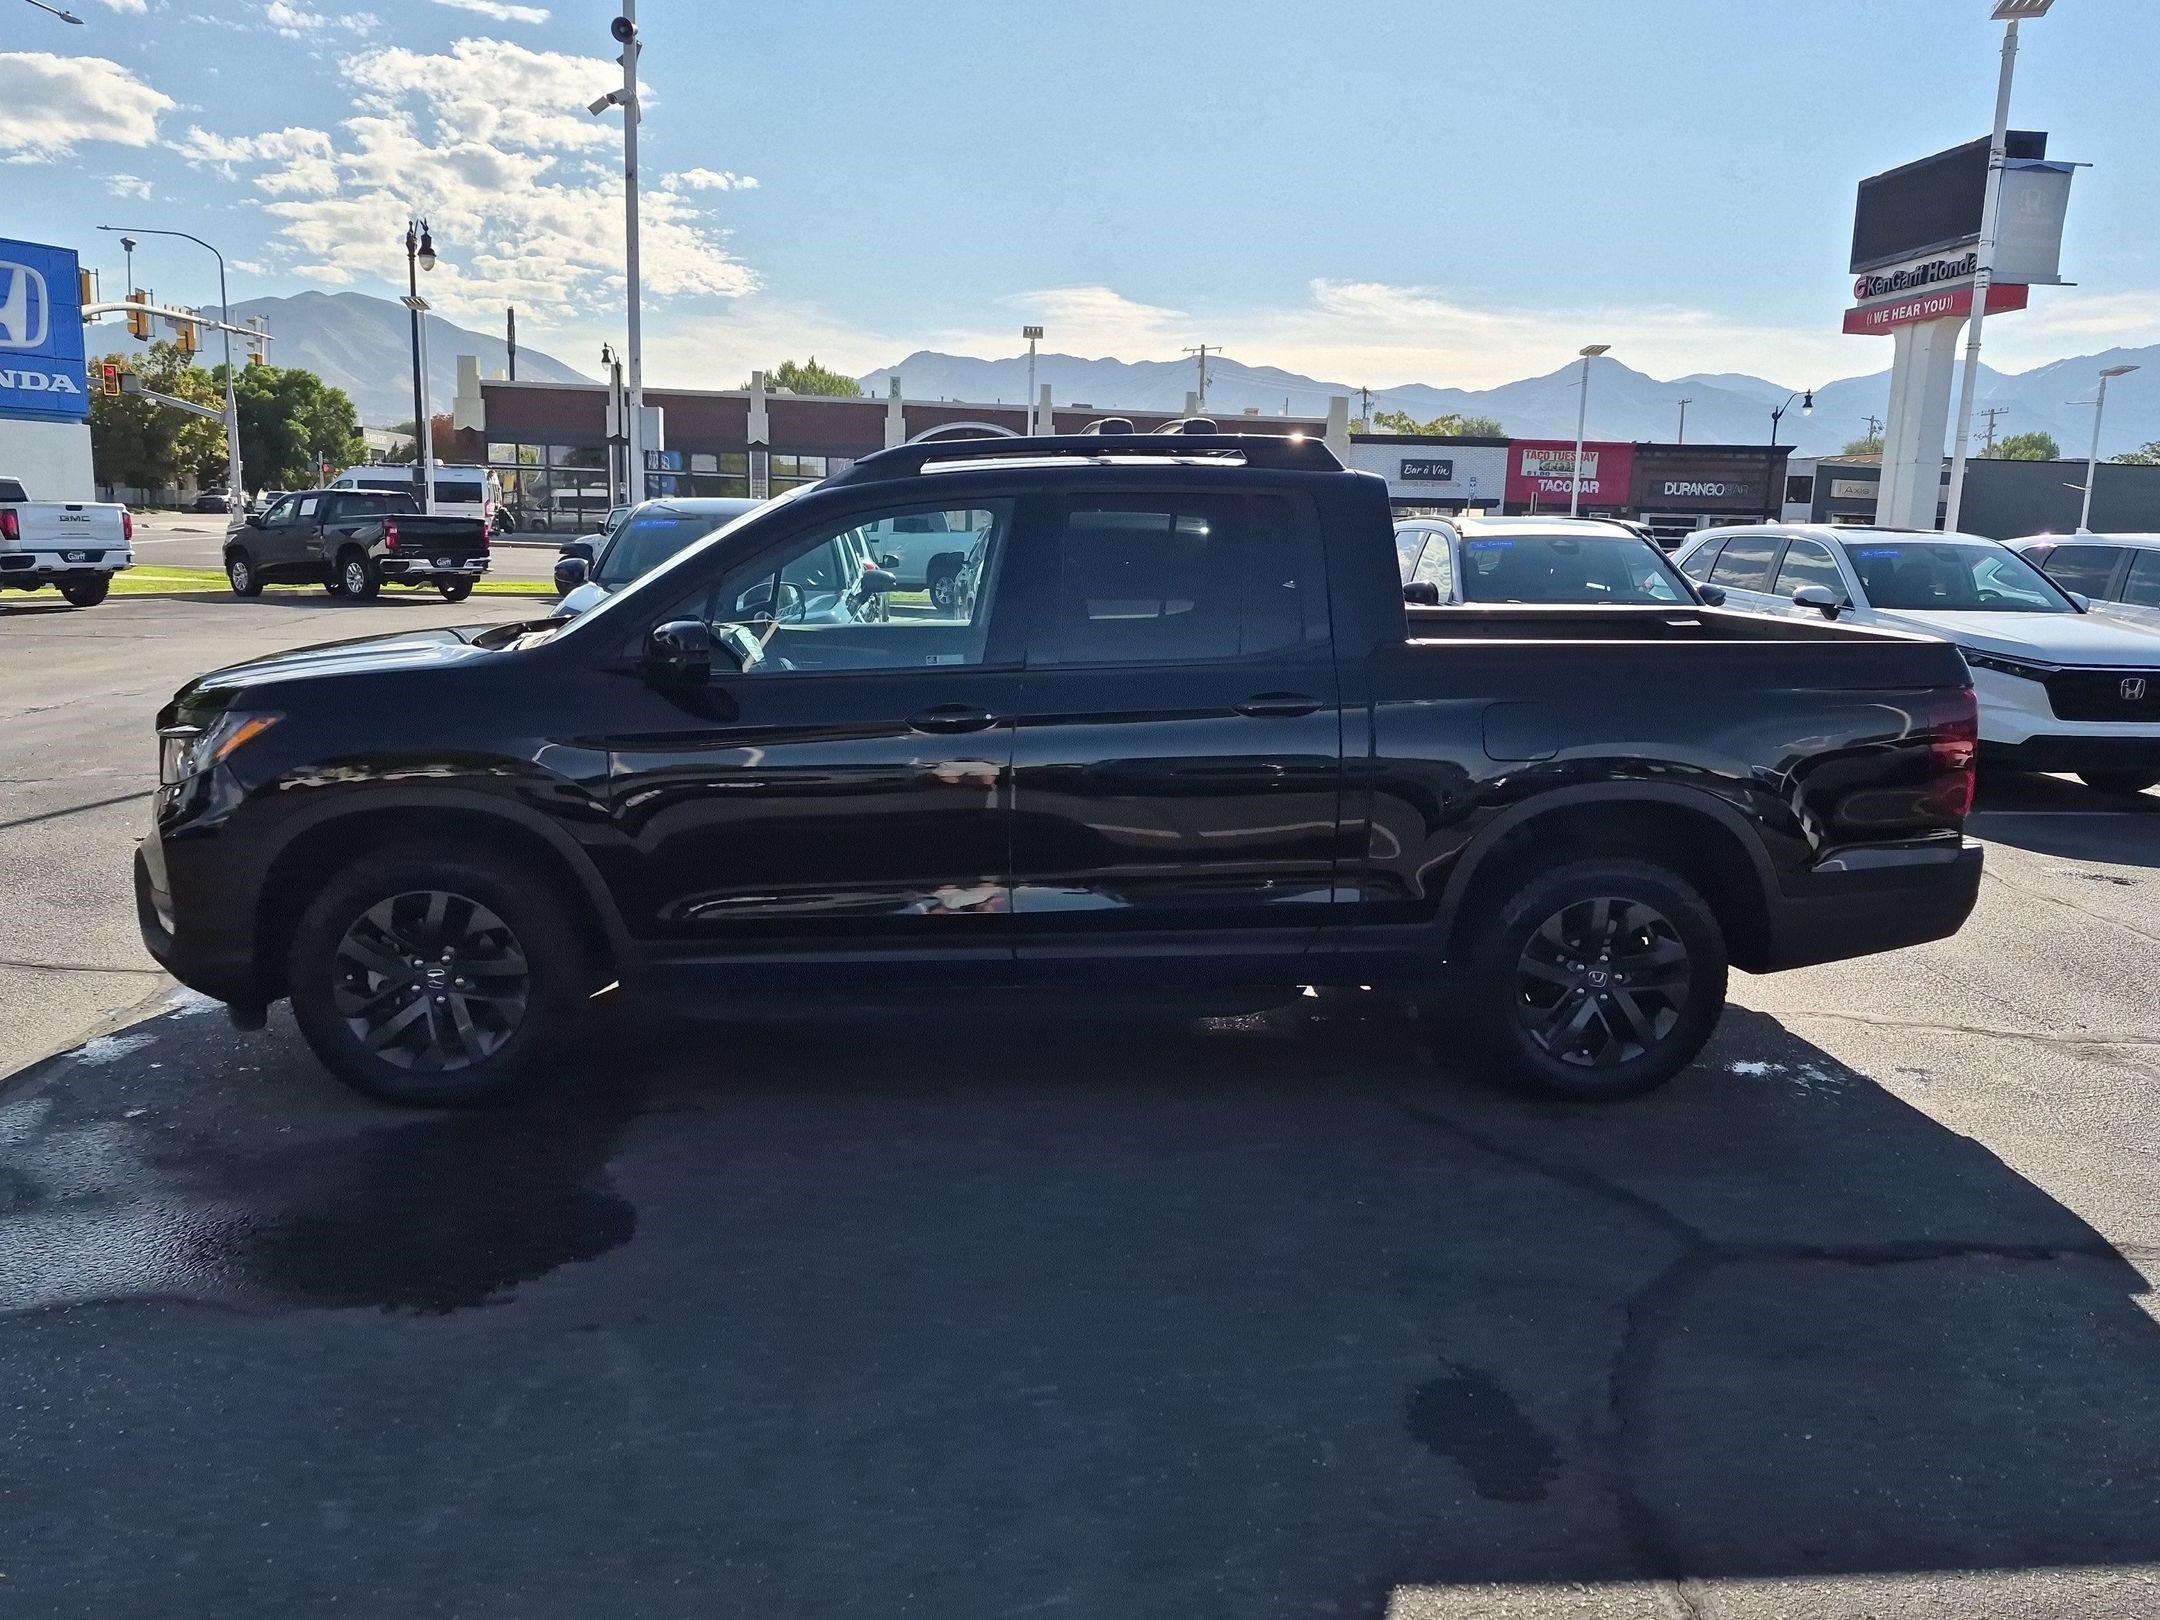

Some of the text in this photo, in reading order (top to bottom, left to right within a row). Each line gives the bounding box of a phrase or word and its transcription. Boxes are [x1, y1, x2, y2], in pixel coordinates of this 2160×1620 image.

[1927, 253, 1978, 282] Honda
[1891, 303, 1921, 321] HEAR
[1525, 450, 1597, 462] TACO TUESAY
[1403, 464, 1422, 475] Bar
[1432, 464, 1450, 475] Vin
[1664, 481, 1725, 496] DURANGO
[1844, 485, 1870, 495] Axis
